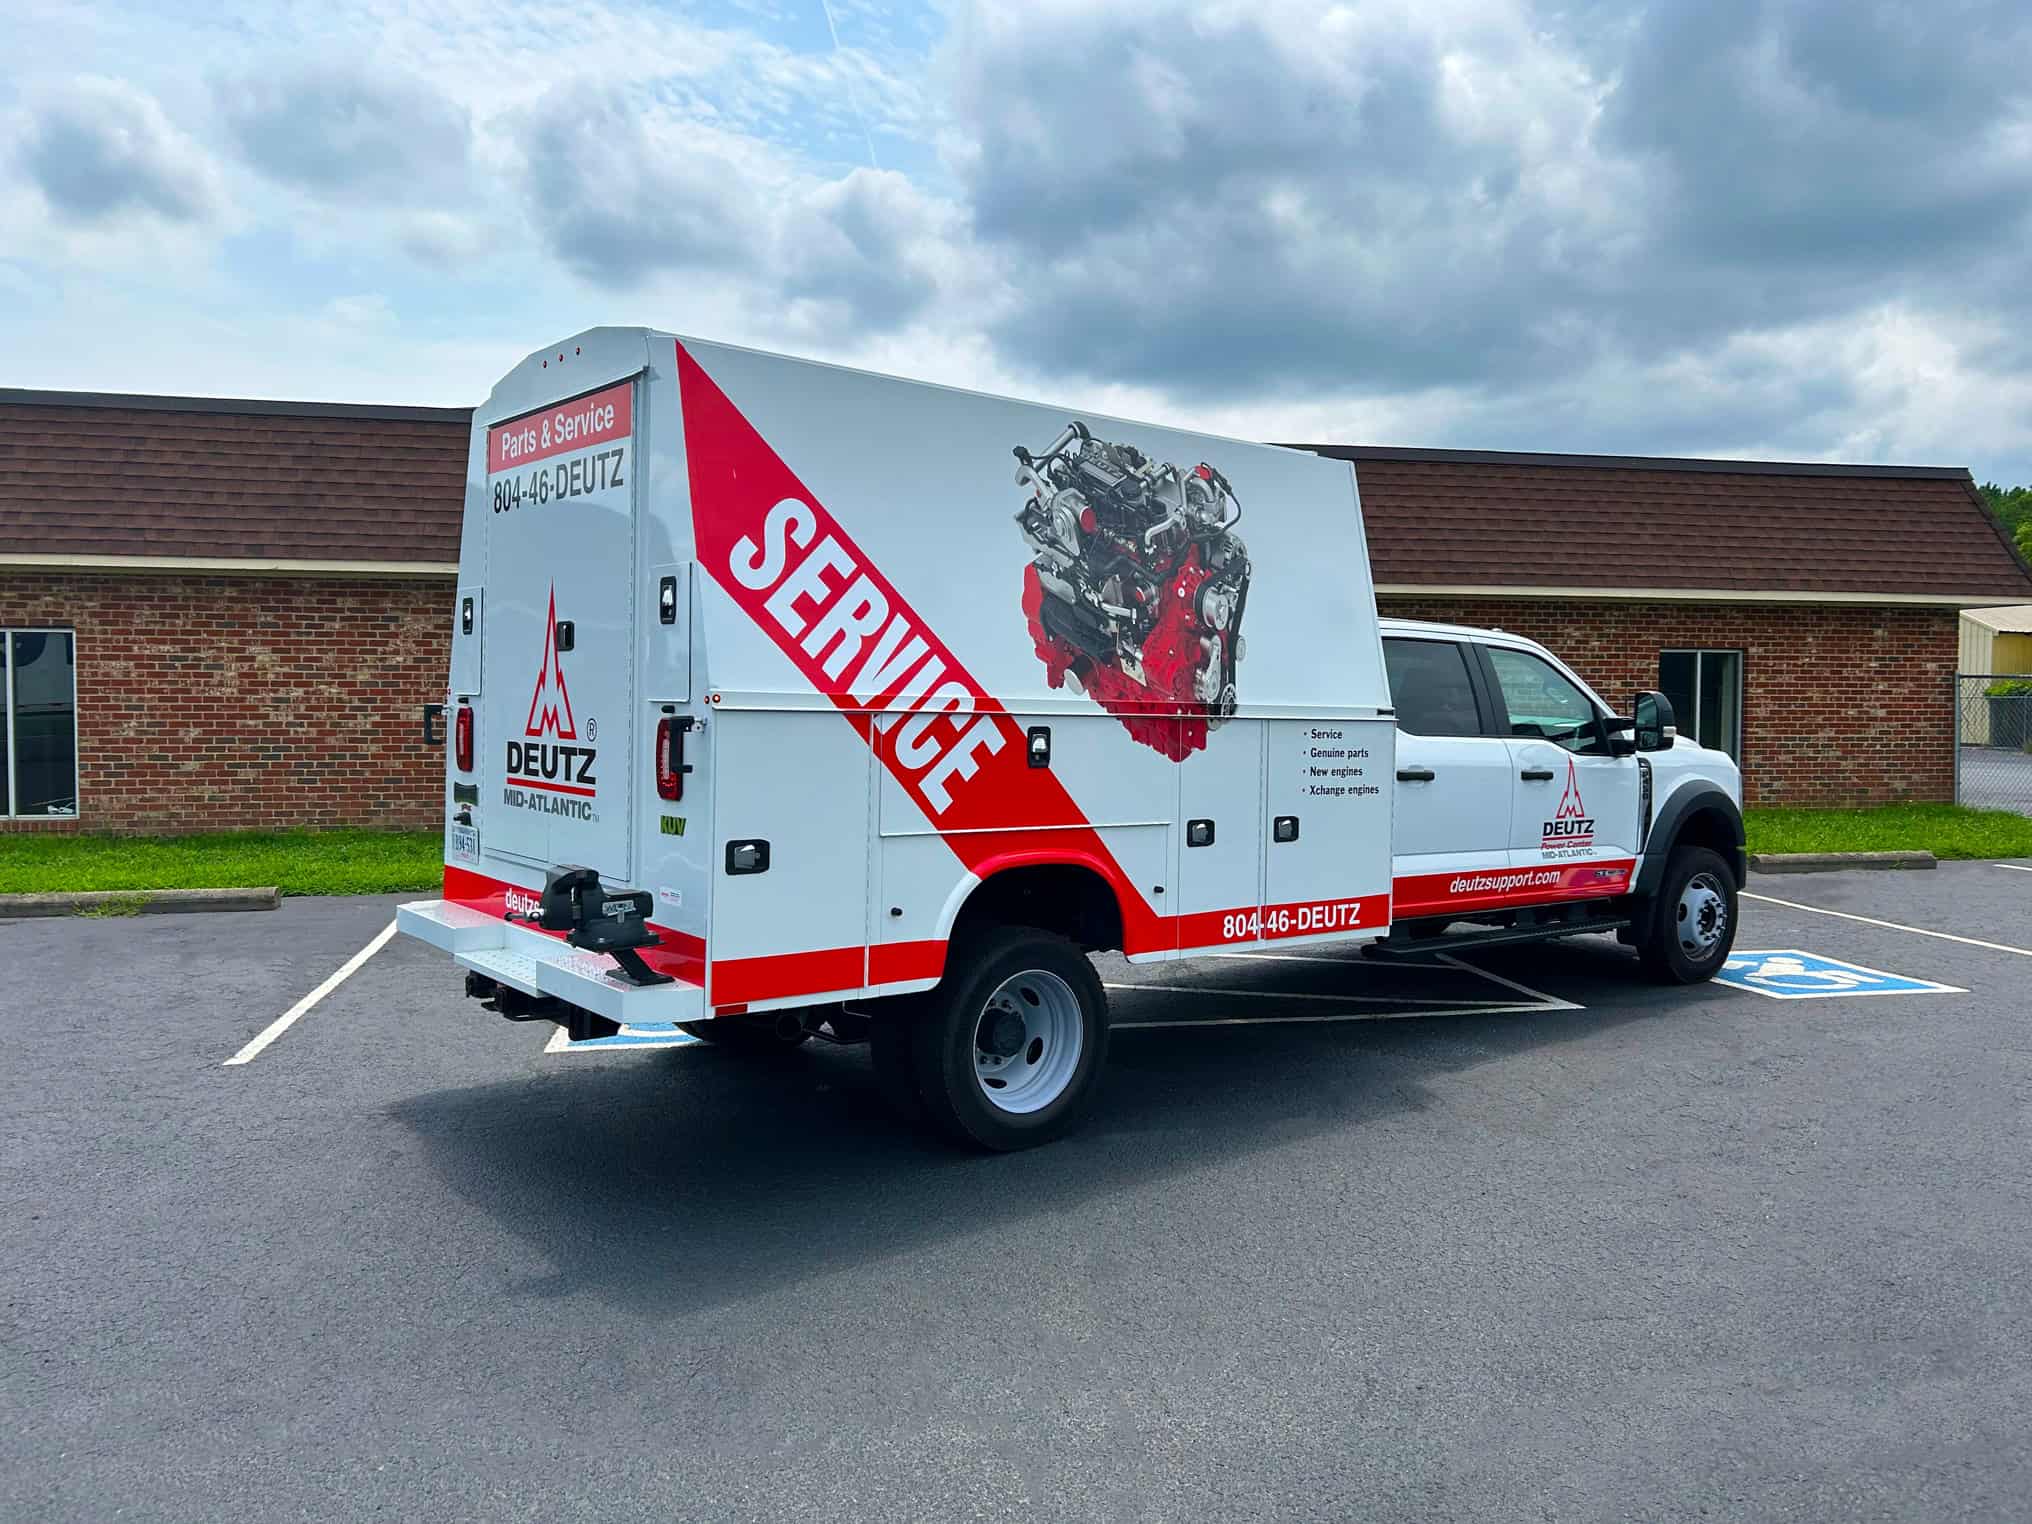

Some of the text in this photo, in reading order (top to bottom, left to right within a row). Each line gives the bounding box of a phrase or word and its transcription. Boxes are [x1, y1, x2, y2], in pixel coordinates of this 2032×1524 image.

[502, 402, 615, 461] Parts & Service
[494, 448, 624, 514] 804-46-DEUTZ
[729, 497, 1007, 816] SERVICE
[1311, 728, 1343, 739] Service
[507, 741, 597, 785] DEUTZ
[1310, 747, 1369, 760] Genuine parts
[1310, 766, 1363, 778] New engines
[1310, 784, 1379, 797] Xchange engines
[503, 788, 593, 821] MID-ATLANTIC
[661, 815, 687, 837] KUV
[1543, 819, 1595, 836] DEUTZ
[1450, 870, 1561, 894] deutzsupport.com
[1223, 903, 1361, 938] 804-46-DEUTZ
